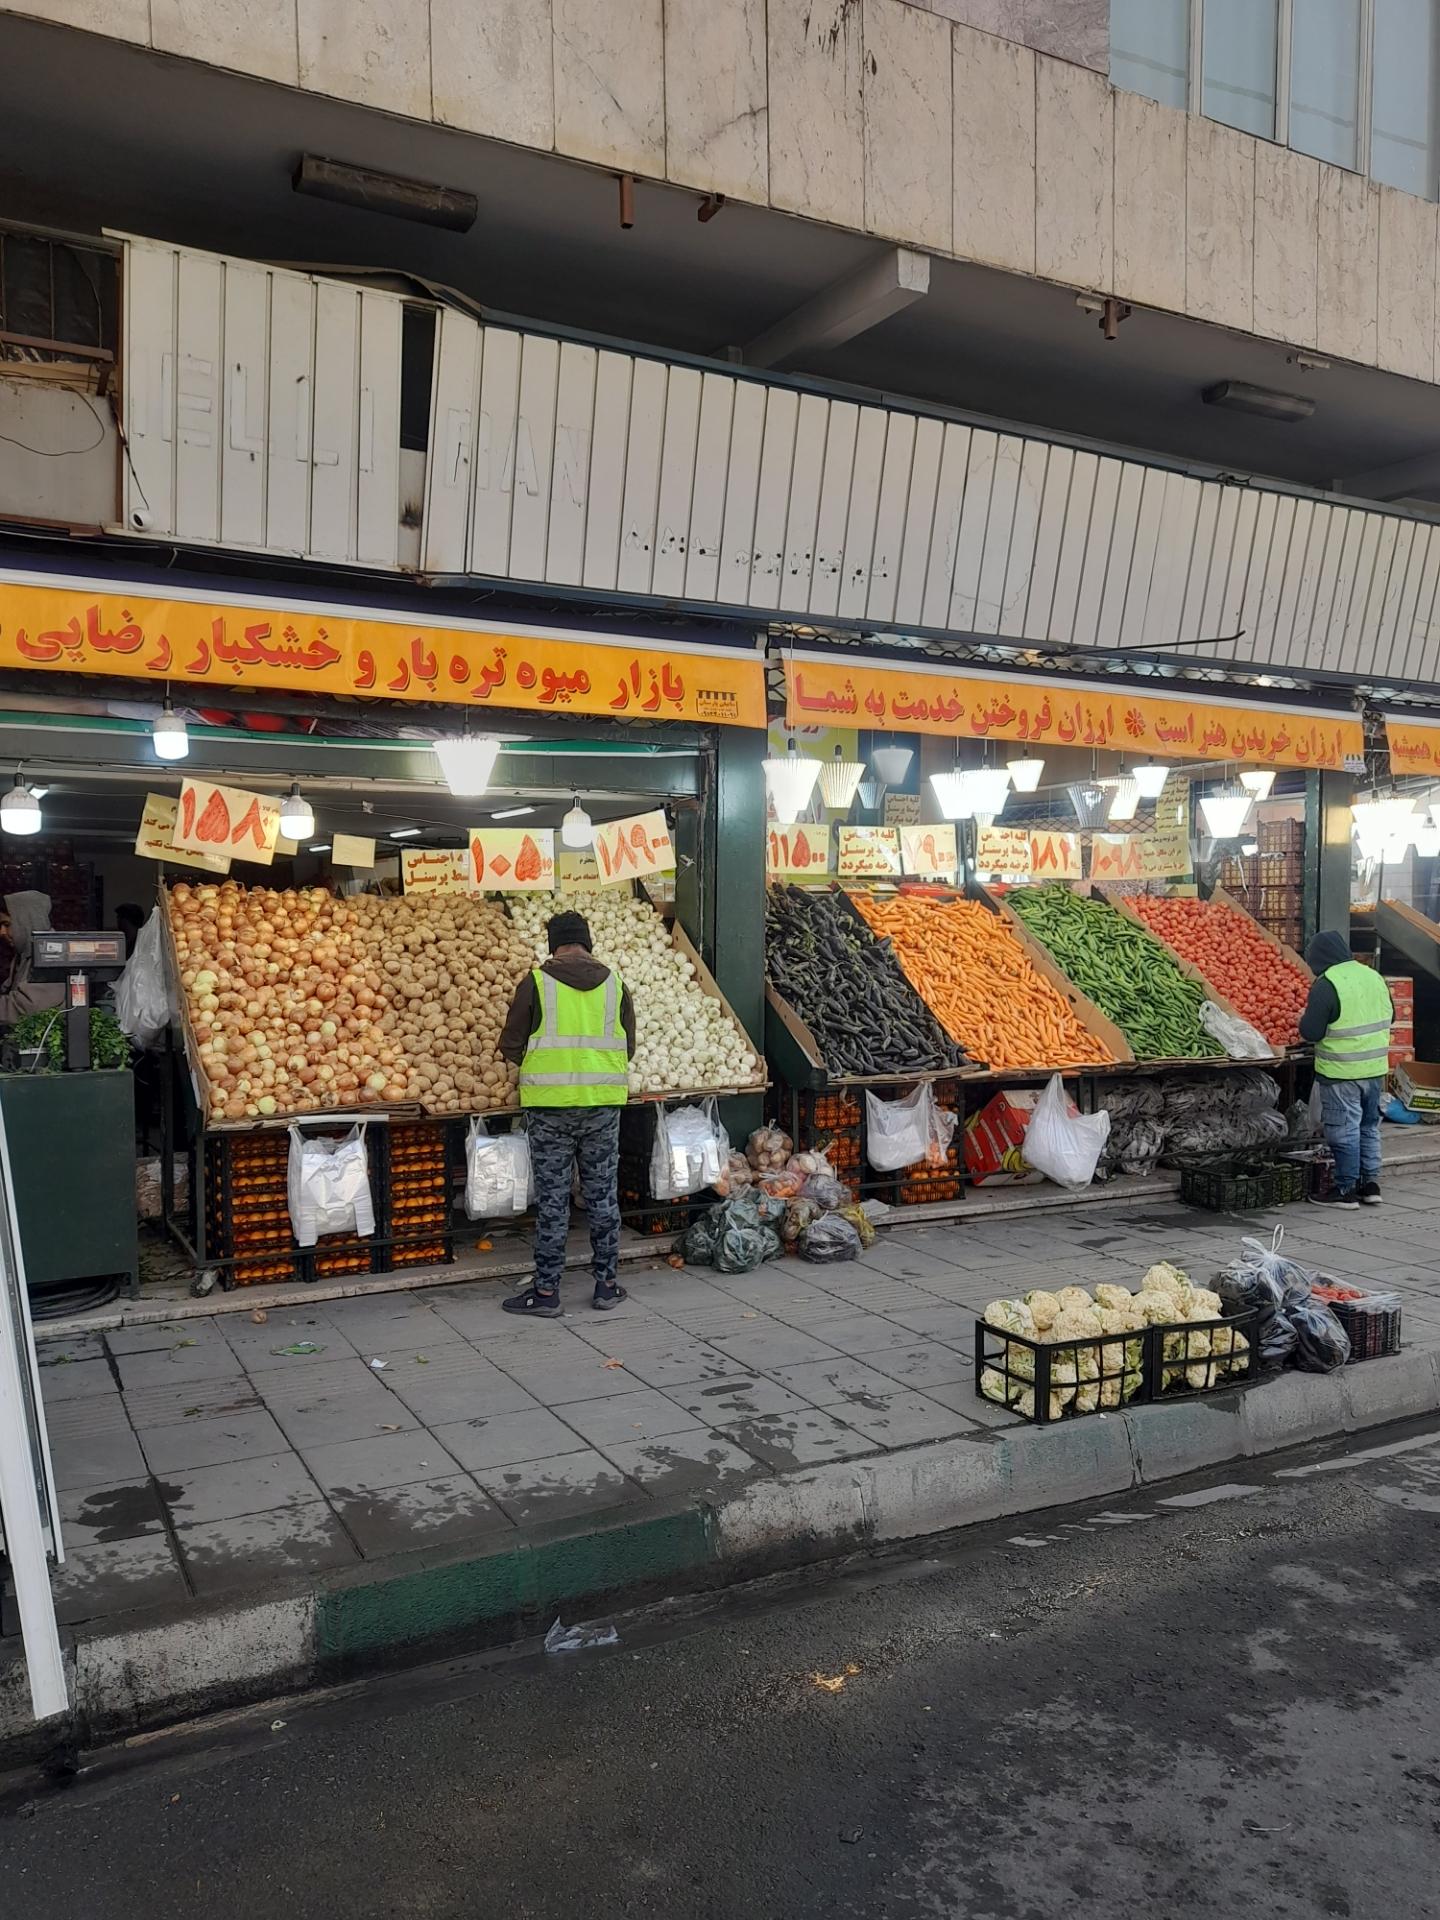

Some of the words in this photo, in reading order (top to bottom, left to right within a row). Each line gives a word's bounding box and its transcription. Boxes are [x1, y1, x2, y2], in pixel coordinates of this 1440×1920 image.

[15, 604, 172, 671] رضایی
[185, 616, 342, 677] خشکبار
[353, 647, 377, 688] و
[387, 637, 439, 693] بار
[449, 646, 508, 697] تره
[516, 661, 591, 704] میوه
[609, 659, 685, 712] بازار
[794, 672, 858, 714] شما
[864, 687, 886, 726] به
[891, 688, 965, 722] خدمت
[970, 694, 1052, 740] فروختن
[1058, 701, 1114, 745] ارزان
[1154, 712, 1195, 743] است
[1197, 720, 1228, 755] هنر
[1231, 723, 1291, 761] خریدن
[1295, 729, 1342, 765] ارزان
[1392, 735, 1431, 763] همیشه
[182, 786, 267, 850] ۱۵۸
[880, 828, 895, 842] کلیه
[407, 851, 454, 868] اجناس
[471, 833, 543, 884] ۱۰۵
